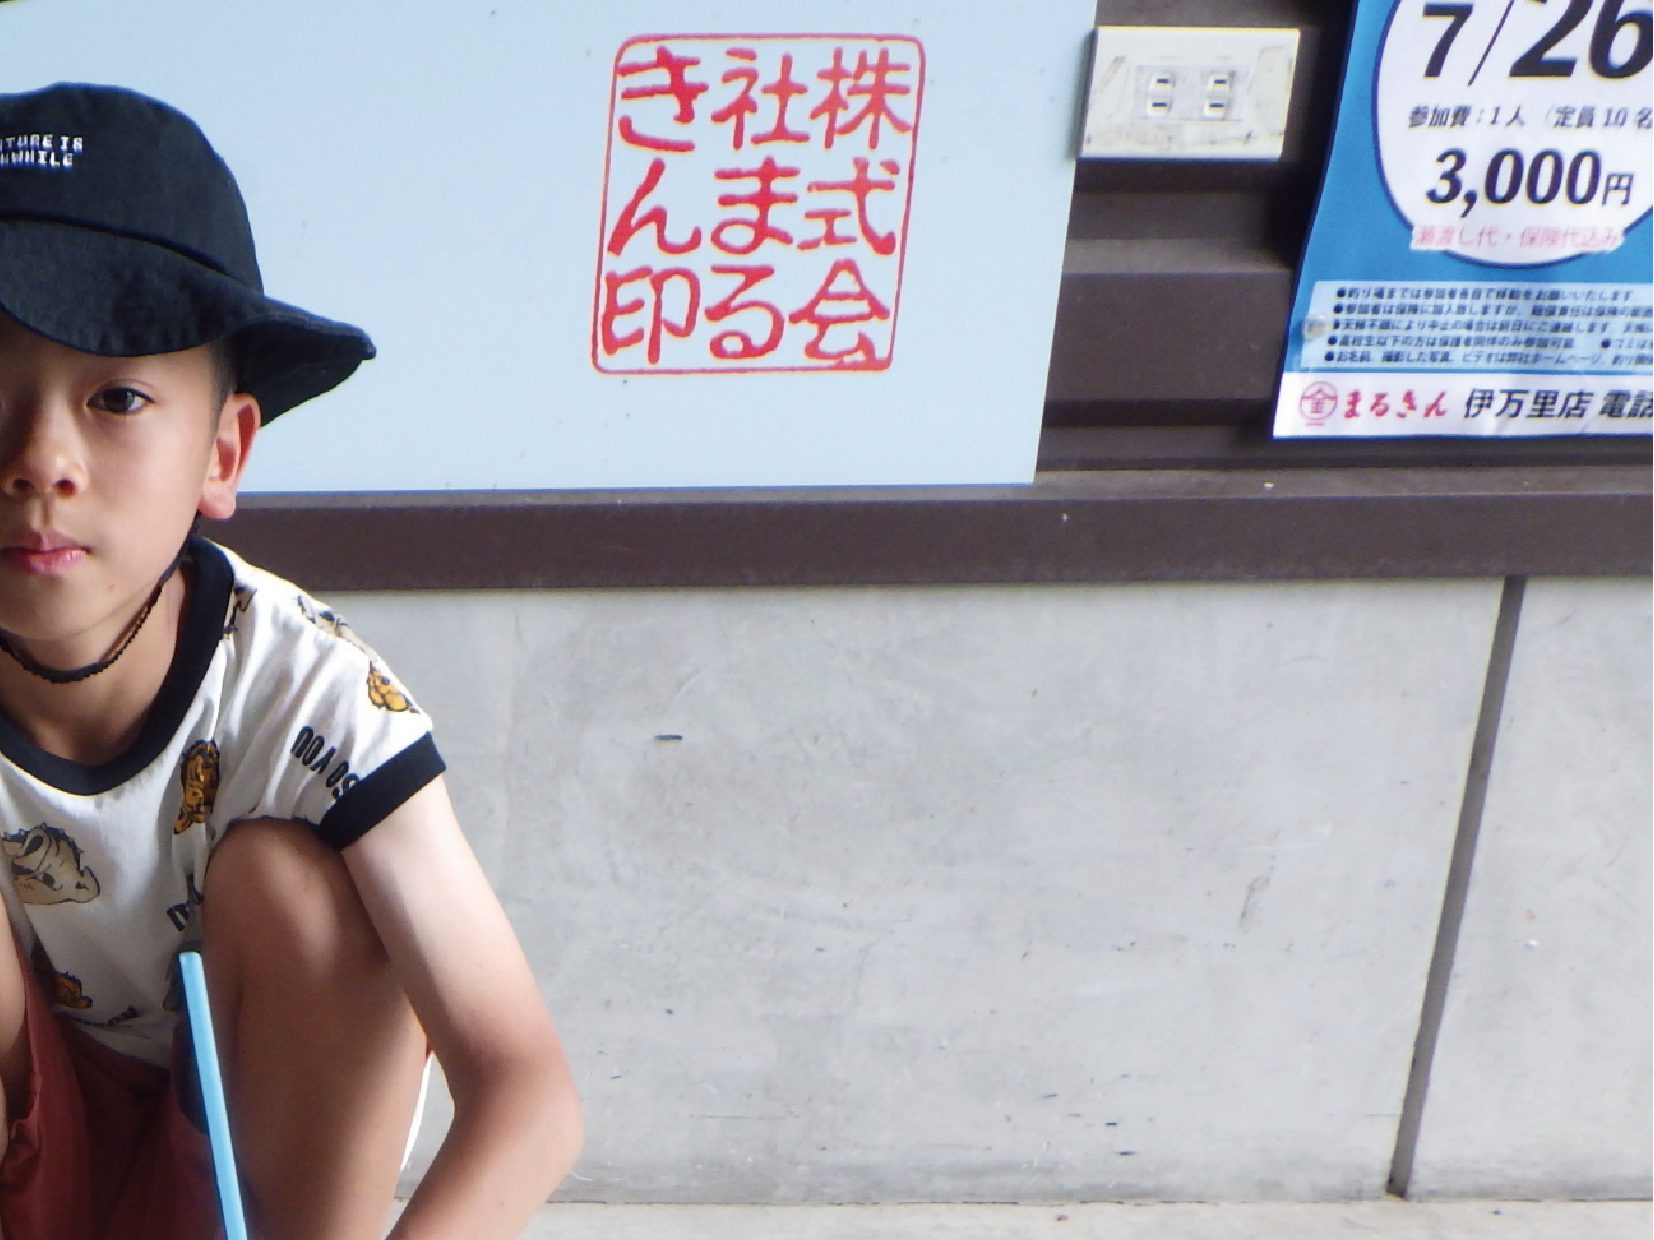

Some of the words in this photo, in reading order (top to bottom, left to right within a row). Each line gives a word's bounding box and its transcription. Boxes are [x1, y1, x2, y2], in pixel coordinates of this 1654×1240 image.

[1422, 0, 1652, 86] 7/26
[60, 135, 84, 153] IS
[1426, 148, 1634, 218] 3,000円
[602, 46, 709, 364] きん印
[704, 47, 810, 360] 社まる
[789, 47, 912, 368] 株式会
[1344, 389, 1447, 418] まるきん
[1464, 388, 1594, 418] 伊万里店
